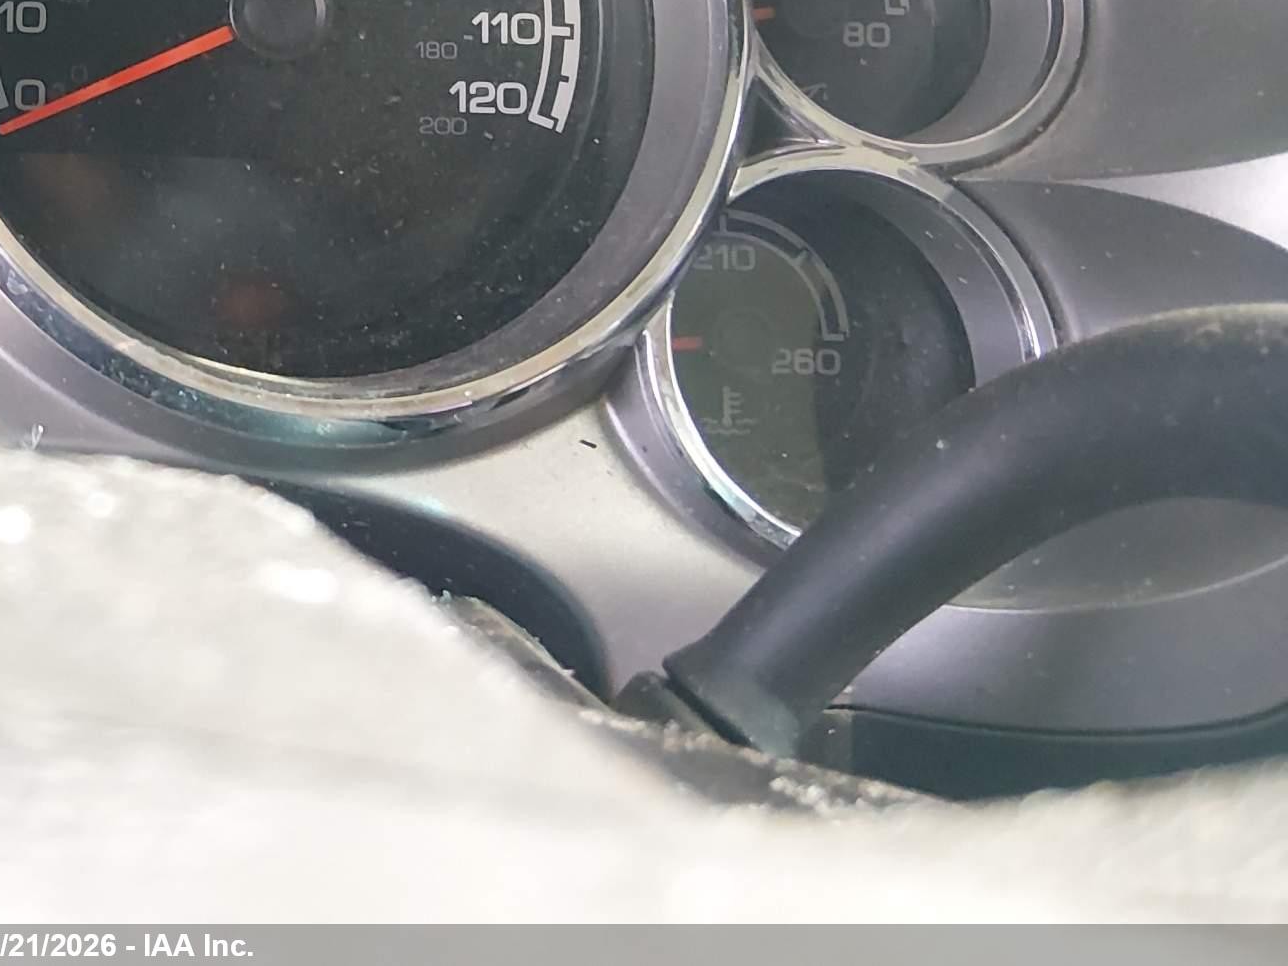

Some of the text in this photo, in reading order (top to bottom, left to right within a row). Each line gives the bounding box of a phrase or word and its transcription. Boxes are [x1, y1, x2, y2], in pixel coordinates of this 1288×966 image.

[472, 12, 542, 45] 110
[843, 21, 891, 48] 80
[415, 41, 458, 60] 180
[15, 79, 47, 111] 0
[449, 82, 528, 115] 120
[419, 116, 468, 136] 200
[693, 244, 756, 271] 210
[771, 348, 842, 376] 260
